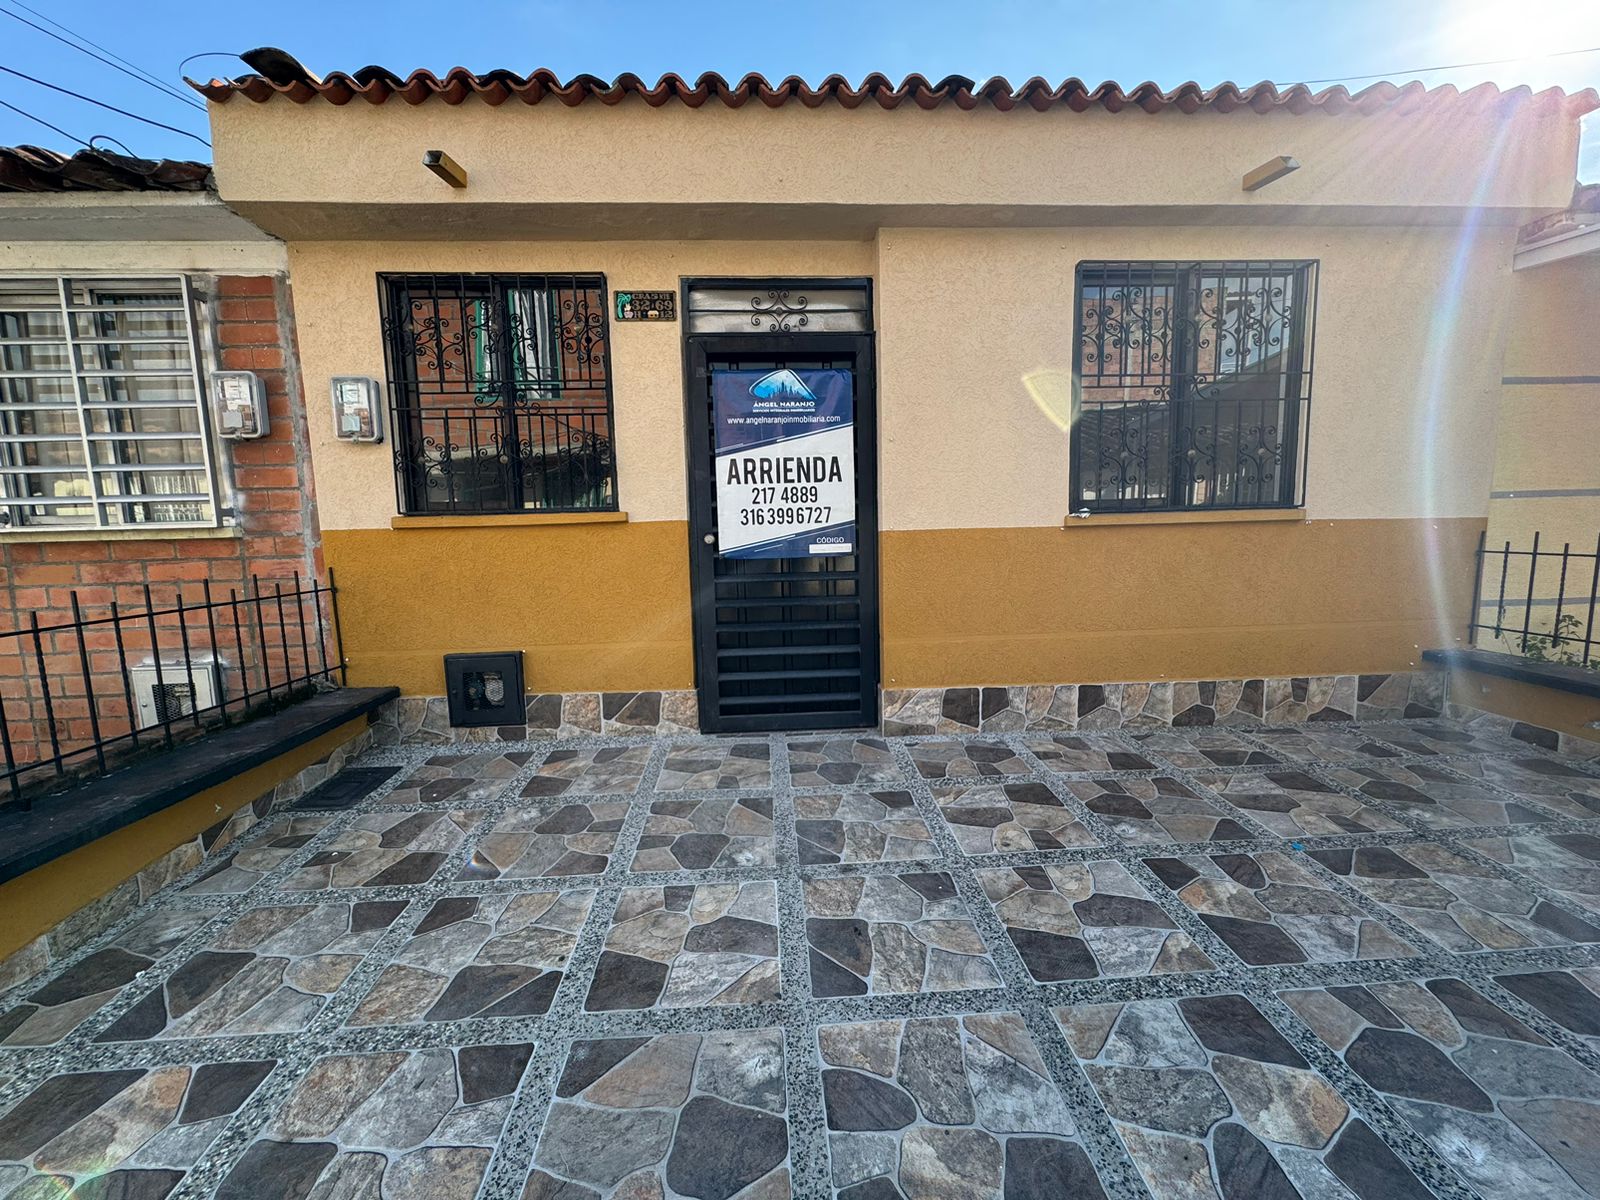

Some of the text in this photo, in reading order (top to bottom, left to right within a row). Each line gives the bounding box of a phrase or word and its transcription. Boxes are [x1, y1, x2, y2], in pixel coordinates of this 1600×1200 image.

[727, 415, 841, 425] www.angelnaranjoinmobiliaria.com
[726, 456, 843, 485] ARRIENDA
[751, 486, 818, 504] 217 4889
[816, 536, 845, 544] CÓDIGO
